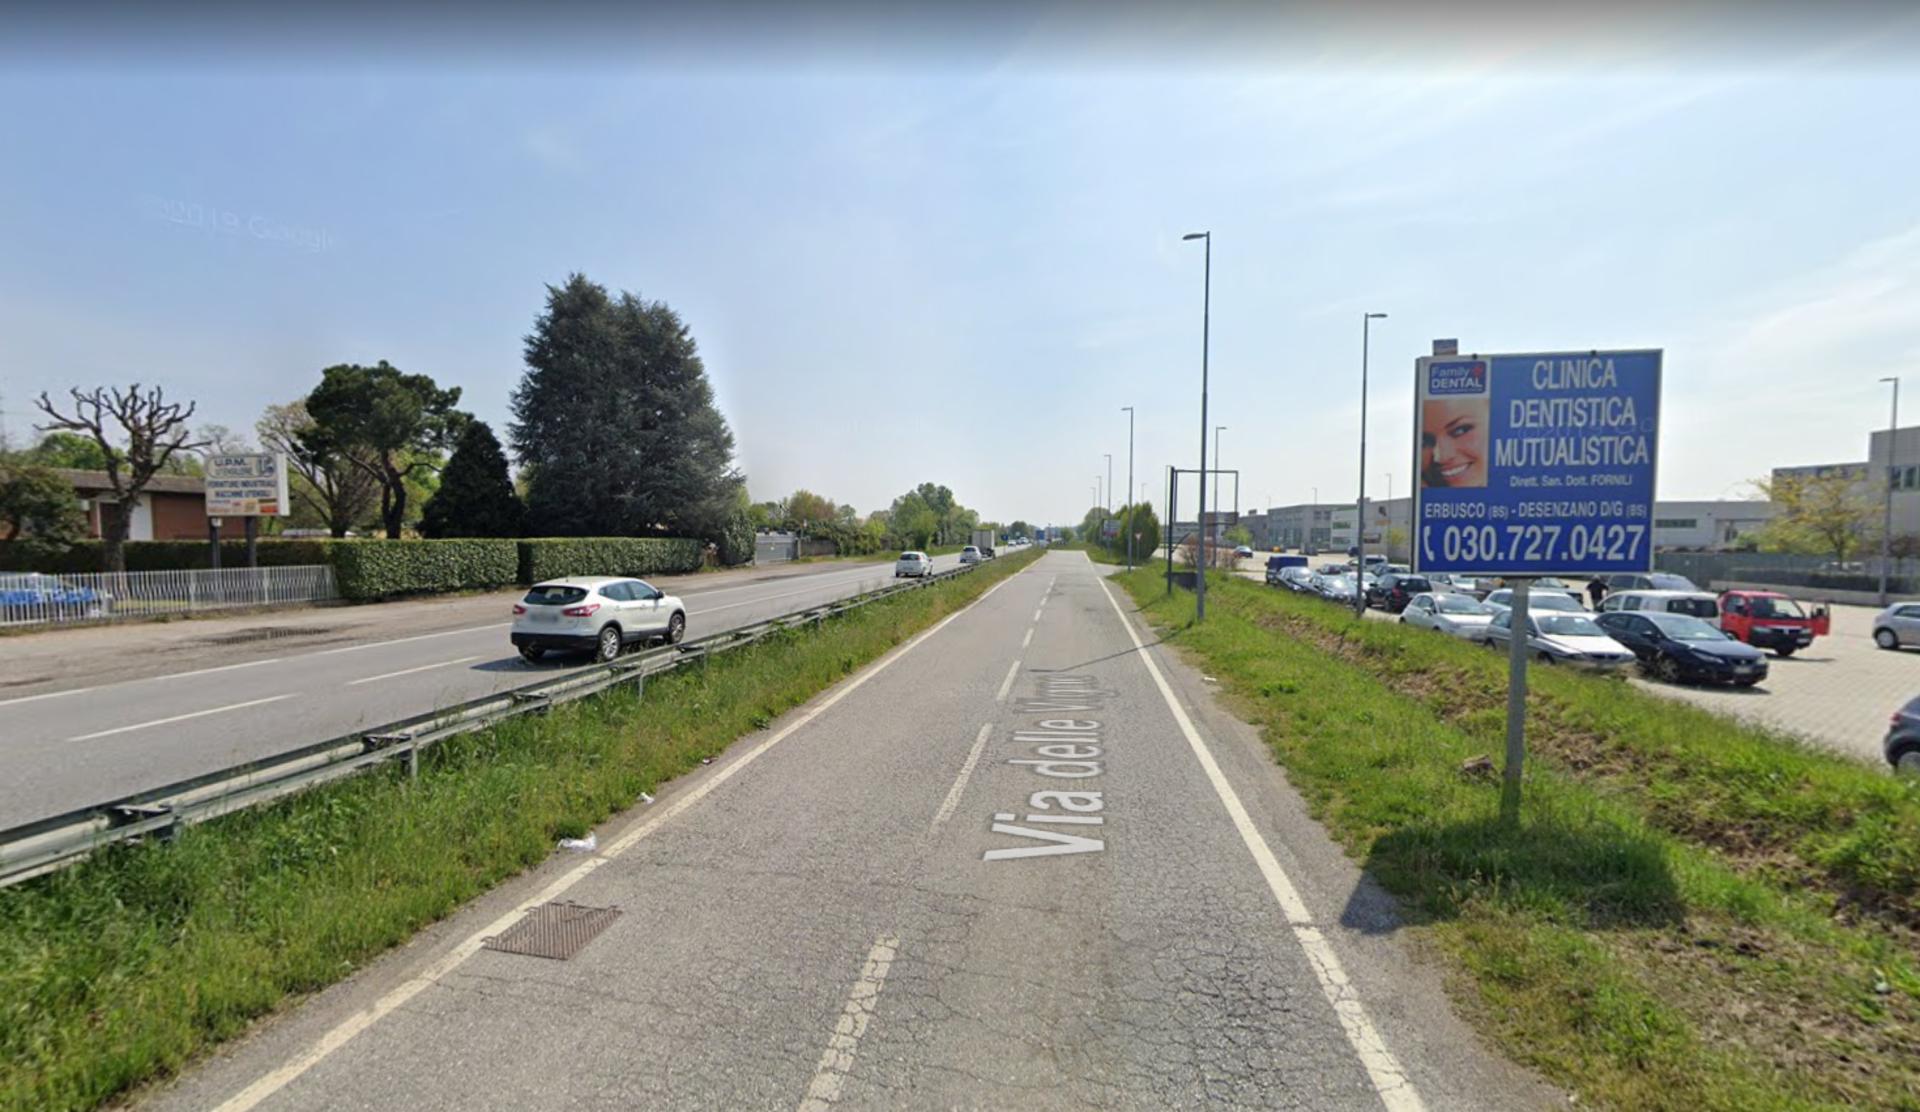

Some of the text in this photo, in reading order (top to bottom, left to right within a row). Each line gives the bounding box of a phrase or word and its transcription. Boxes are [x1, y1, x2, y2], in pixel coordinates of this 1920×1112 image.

[1431, 366, 1470, 380] Family
[1431, 376, 1483, 389] DENTAL
[1532, 360, 1617, 389] CLINICA
[1510, 397, 1636, 428] DENTISTICA
[1495, 436, 1648, 466] MUTUALISTICA
[1424, 502, 1485, 518] ERBUSCO
[1518, 501, 1597, 517] DESENZANO
[1600, 500, 1623, 516] D/G
[1443, 524, 1645, 561] 030.727.0427
